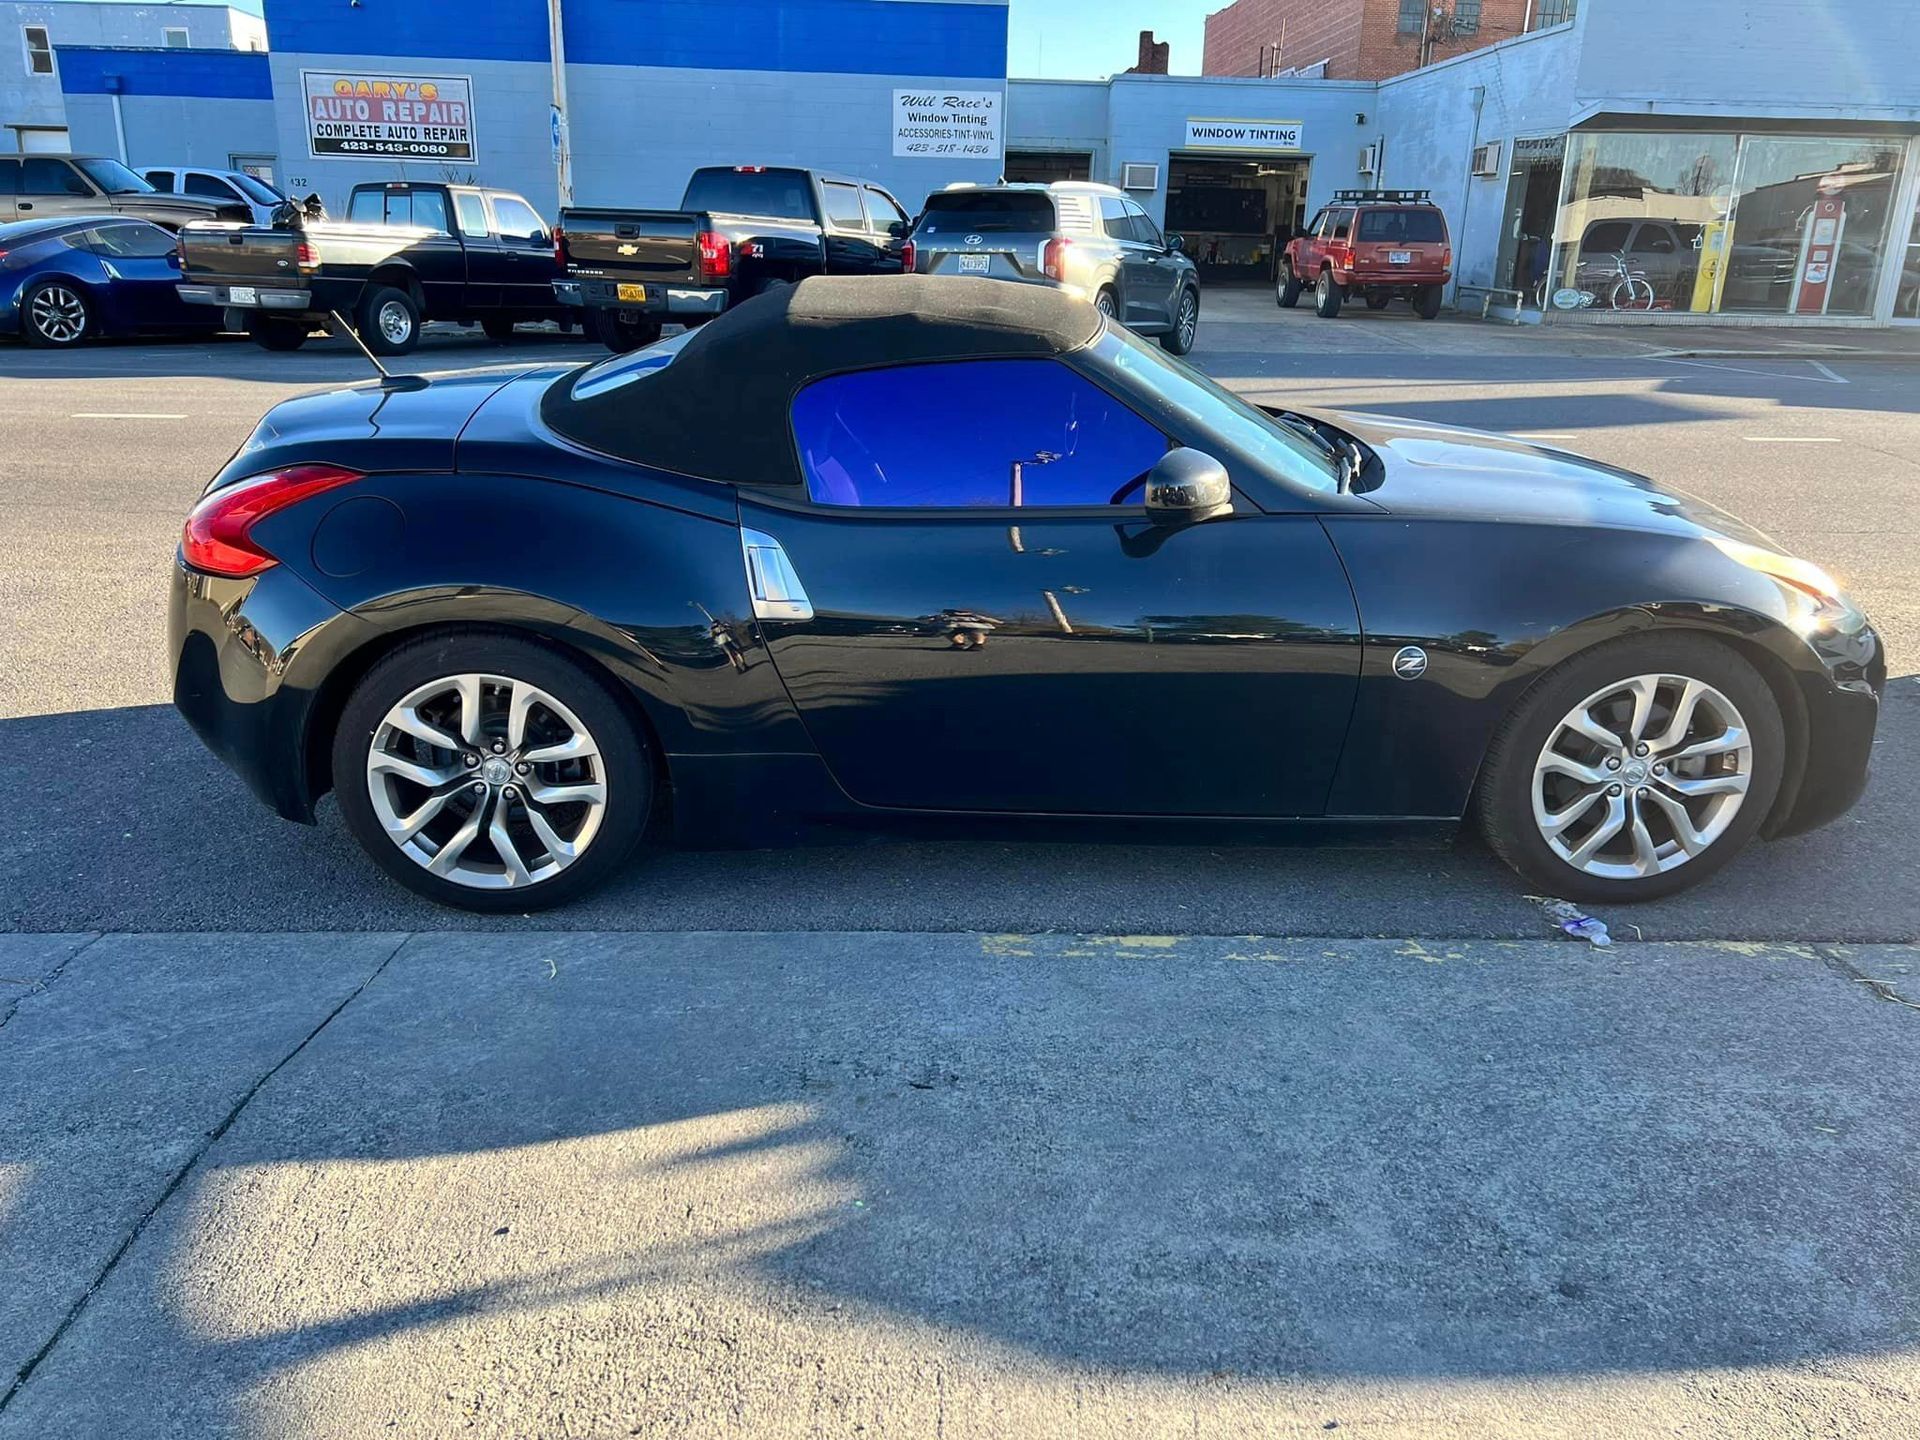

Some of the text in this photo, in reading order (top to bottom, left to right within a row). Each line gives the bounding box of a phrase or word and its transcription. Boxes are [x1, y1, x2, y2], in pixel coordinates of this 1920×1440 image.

[333, 79, 438, 100] GARY'S
[900, 95, 993, 109] Will Race's
[315, 98, 466, 125] AUTO REPAIR
[908, 112, 988, 126] Window Tinting
[316, 123, 468, 142] COMPLETE AUTO REPAIR
[898, 128, 995, 140] ACCESSORIES-TINT-VINYL
[1192, 127, 1297, 141] WINDOW TINTING
[340, 140, 448, 155] 423-543-0080
[906, 143, 990, 154] 423-518-1436
